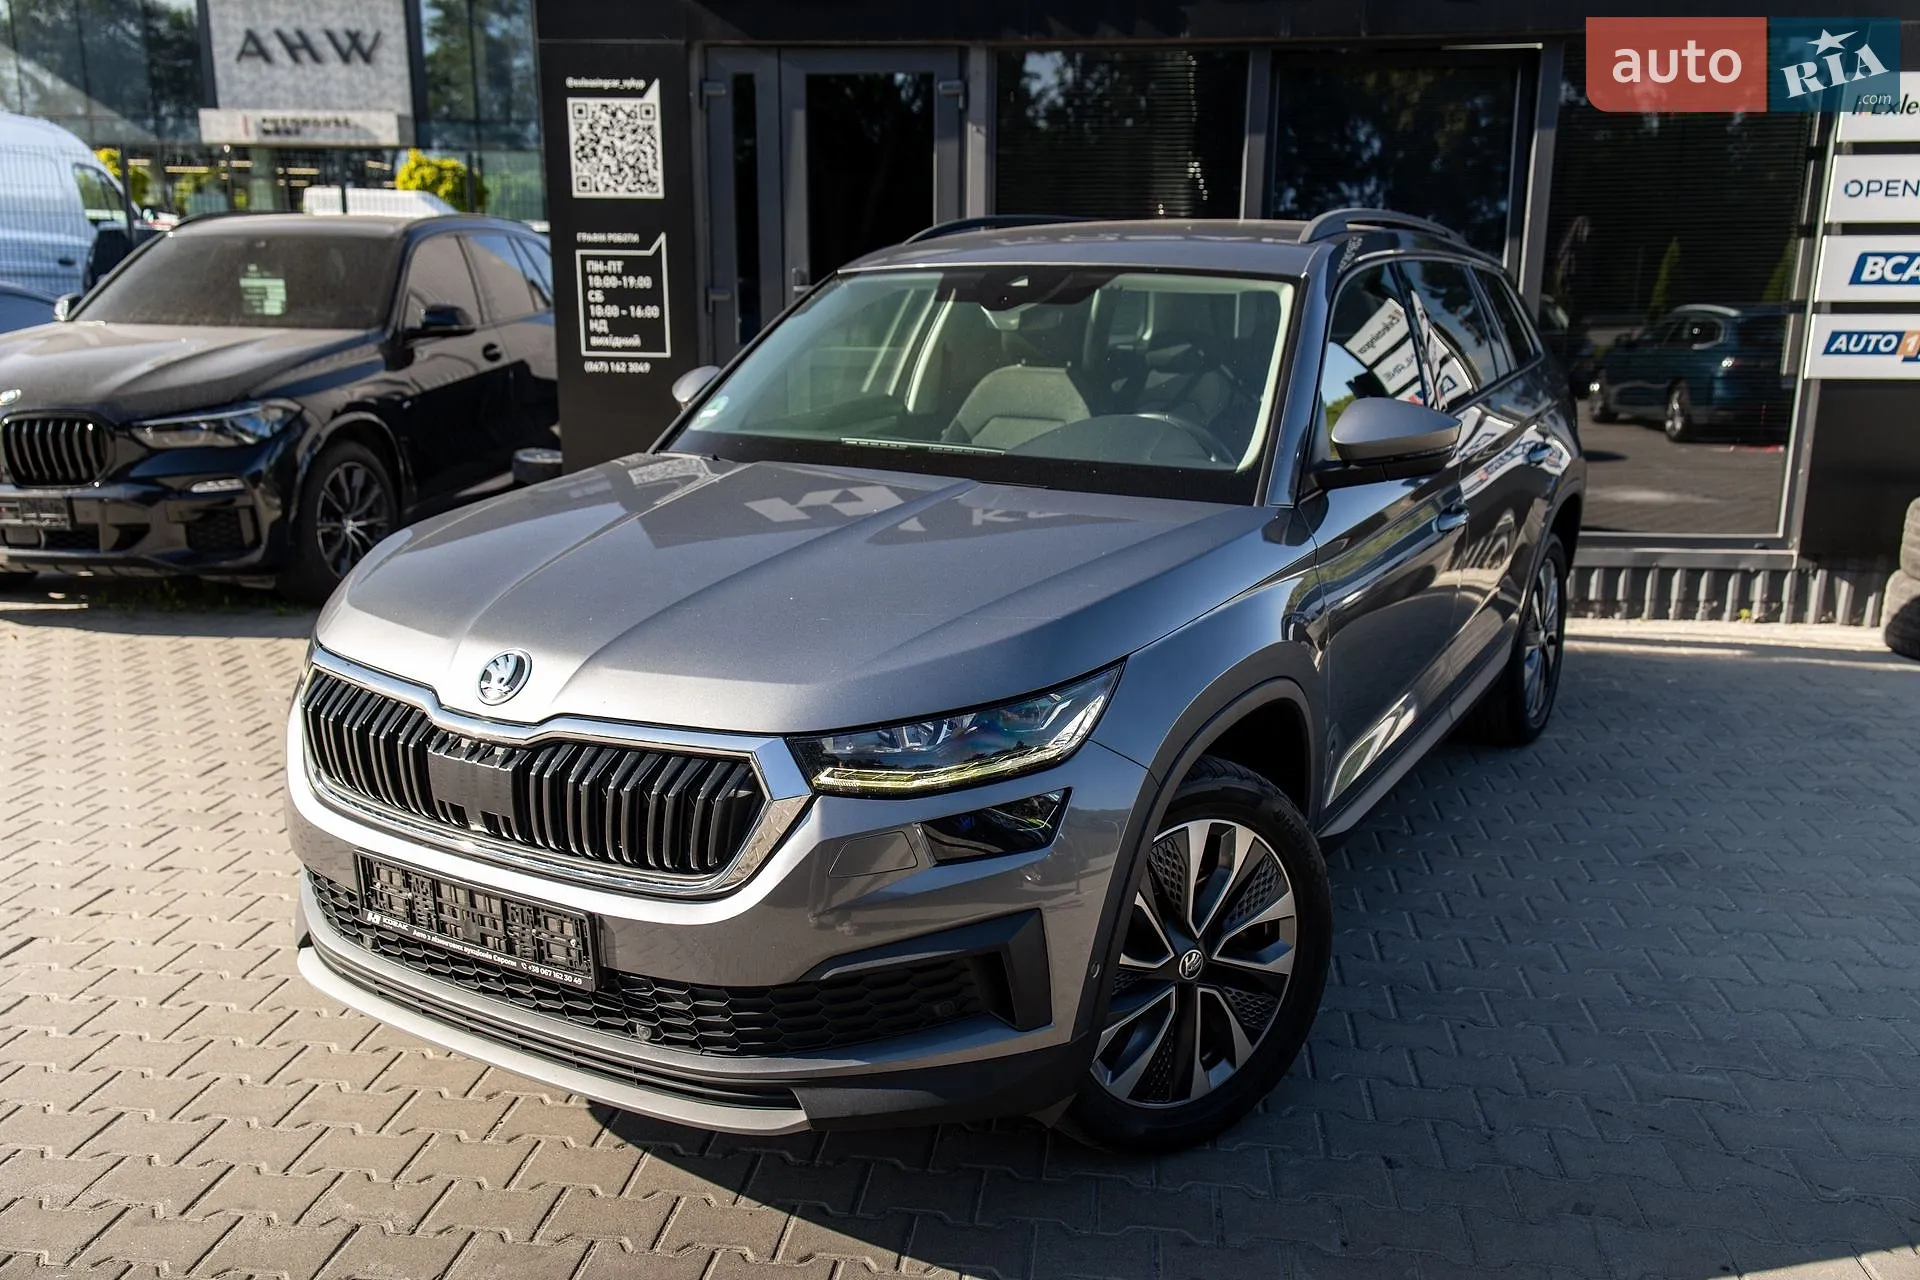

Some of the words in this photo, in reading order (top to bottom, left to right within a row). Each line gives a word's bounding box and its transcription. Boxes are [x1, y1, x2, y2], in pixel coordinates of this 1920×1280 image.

[236, 27, 381, 64] AHW
[1844, 179, 1920, 197] OPEN
[586, 260, 624, 274] ПН-ПТ
[1860, 255, 1920, 282] BCA
[587, 289, 605, 303] СБ
[589, 319, 609, 334] НД
[610, 361, 627, 373] 162
[528, 964, 540, 974] +38
[540, 967, 552, 977] 067
[552, 970, 564, 979] 162
[563, 973, 573, 982] 30
[573, 975, 583, 985] 49
